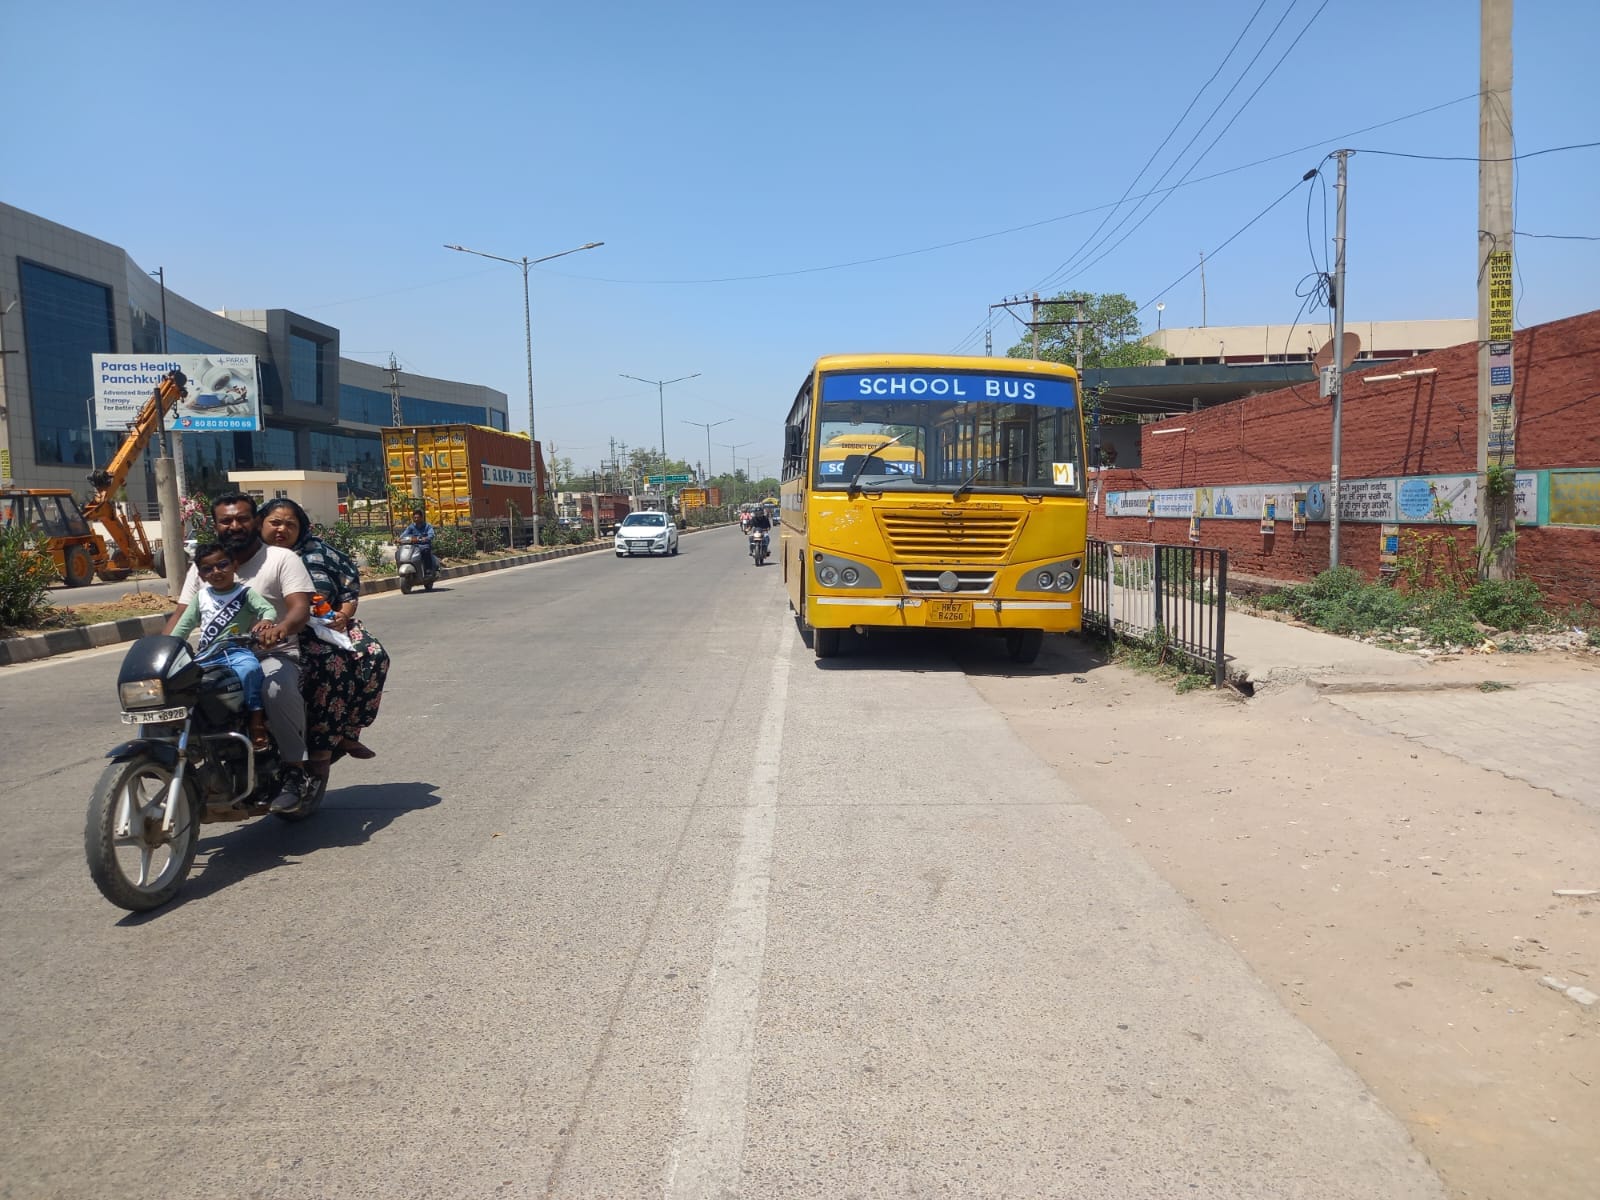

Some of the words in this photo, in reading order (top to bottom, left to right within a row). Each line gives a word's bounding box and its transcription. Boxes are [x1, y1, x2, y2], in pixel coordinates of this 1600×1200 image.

[101, 362, 137, 371] Paras
[140, 361, 181, 372] Health
[859, 378, 966, 395] SCHOOL
[985, 380, 1036, 399] BUS
[1053, 464, 1069, 482] M
[214, 600, 241, 627] BEAR
[942, 604, 961, 612] HR67
[143, 713, 154, 721] AH
